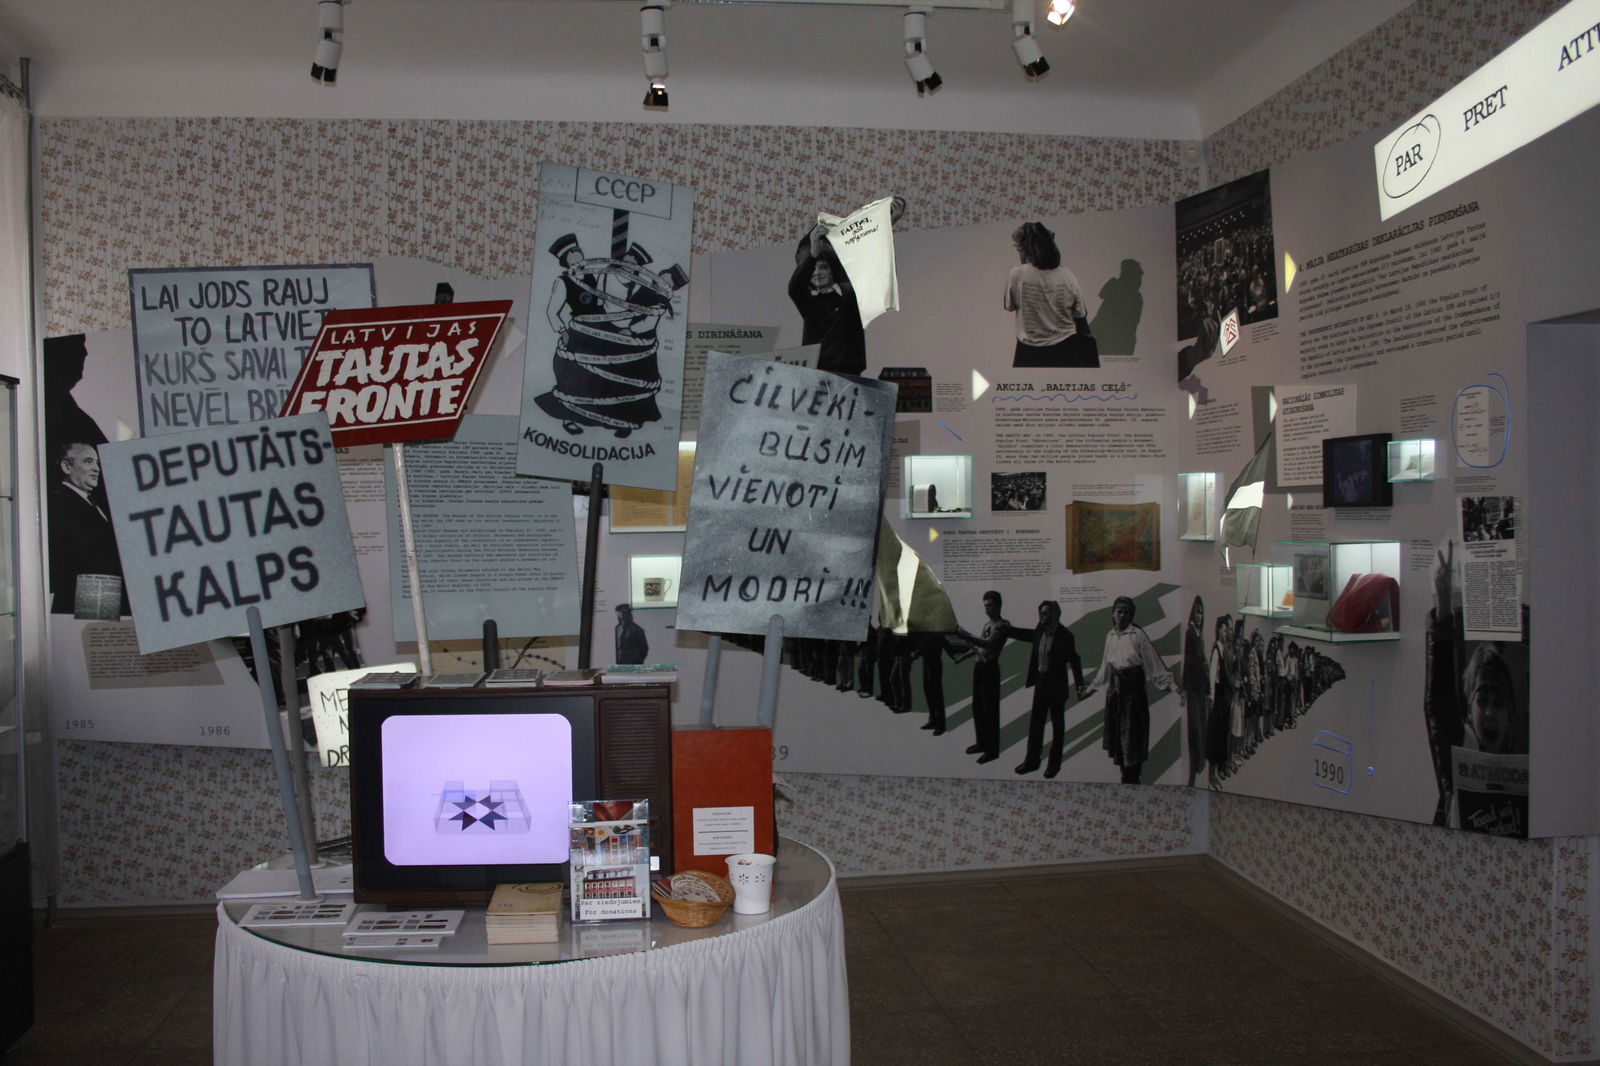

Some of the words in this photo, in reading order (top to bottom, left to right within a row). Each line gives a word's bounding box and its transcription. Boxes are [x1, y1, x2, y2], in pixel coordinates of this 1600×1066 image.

[1463, 84, 1509, 132] PRET
[1395, 143, 1424, 177] PAR
[141, 284, 179, 312] LAI
[188, 279, 252, 310] JODS
[262, 277, 330, 307] RAUJ
[173, 316, 213, 347] TO
[331, 321, 477, 345] LATVIJAS
[698, 328, 764, 340] DIBINĀŠANA
[144, 347, 217, 386] KURŠ
[224, 347, 288, 381] SAVAI
[316, 338, 480, 387] TAUTAS
[299, 377, 464, 425] FRONTE
[995, 383, 1035, 392] AKCIJA
[150, 387, 239, 428] NEVĒL
[131, 425, 332, 492] DEPUTĀTS-
[523, 427, 656, 461] KONSOLIDACIJA
[758, 424, 867, 468] BŪSIM
[708, 464, 843, 510] VIENOTI
[128, 481, 325, 557] TAUTAS
[749, 527, 793, 555] UN
[154, 546, 320, 623] KALPS
[701, 566, 831, 604] MODRI
[65, 719, 95, 731] 1985
[200, 726, 231, 737] 1986
[1313, 758, 1344, 785] 1990
[584, 908, 598, 916] For
[601, 907, 637, 916] donations
